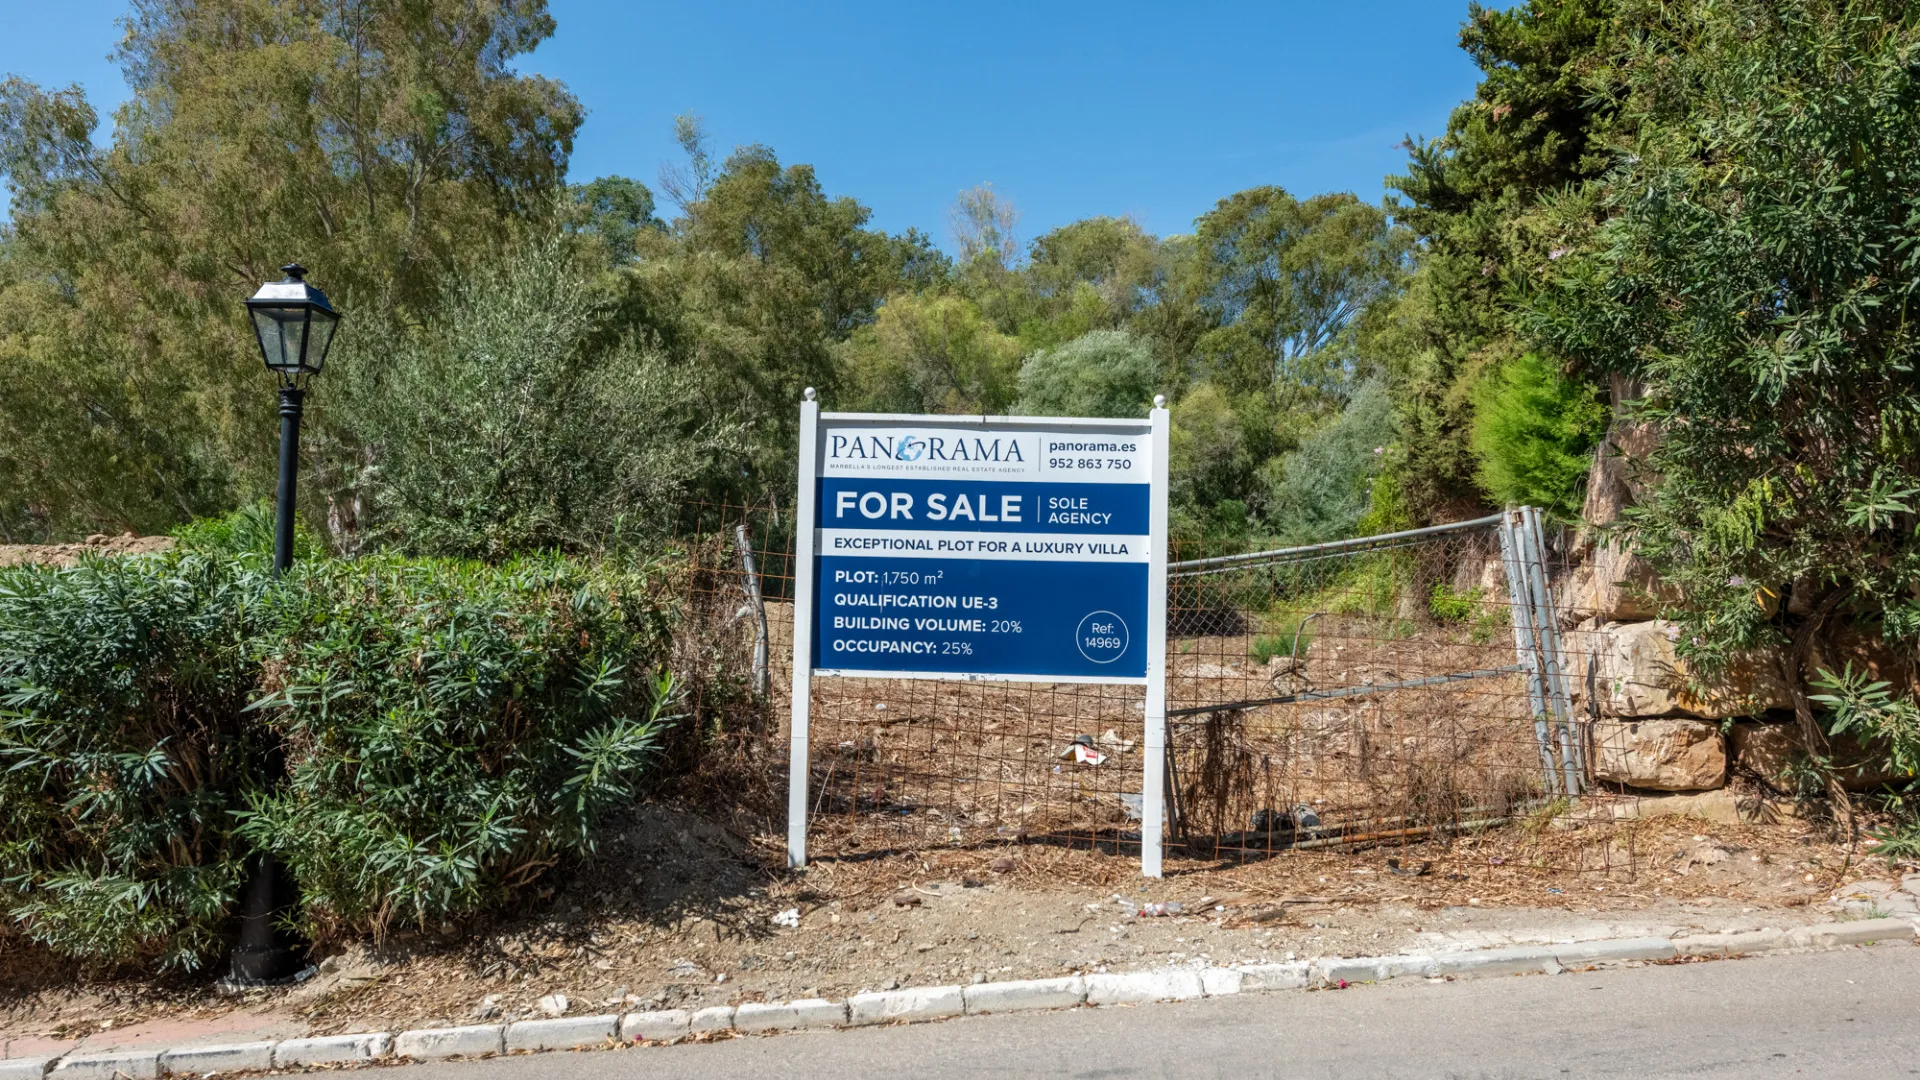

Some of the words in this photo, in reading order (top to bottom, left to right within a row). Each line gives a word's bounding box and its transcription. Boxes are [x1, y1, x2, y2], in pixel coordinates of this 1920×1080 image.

[830, 435, 1025, 462] PANORAMA
[1049, 442, 1137, 453] panorama.es
[1049, 458, 1073, 469] 952
[1077, 458, 1102, 469] 863
[1107, 459, 1132, 470] 750
[835, 491, 914, 520] FOR
[926, 493, 1023, 522] SALE
[1048, 497, 1088, 510] SOLE
[1048, 511, 1112, 525] AGENCY
[834, 537, 934, 551] EXCEPTIONAL
[938, 540, 974, 552] PLOT
[978, 541, 1008, 553] FOR
[1011, 542, 1023, 553] A
[1026, 542, 1085, 554] LUXURY
[1088, 543, 1129, 555] VILLA
[835, 570, 879, 584] PLOT:
[882, 572, 920, 586] 1,750
[834, 593, 957, 609] QUALIFICATION
[962, 596, 999, 609] UE-3
[833, 616, 910, 631] BUILDING
[915, 618, 986, 633] VOLUME:
[991, 620, 1023, 633] 20%
[1091, 623, 1114, 635] Ref:
[833, 639, 937, 654] OCCUPANCY:
[942, 642, 973, 655] 25%
[1085, 637, 1121, 649] 14969
